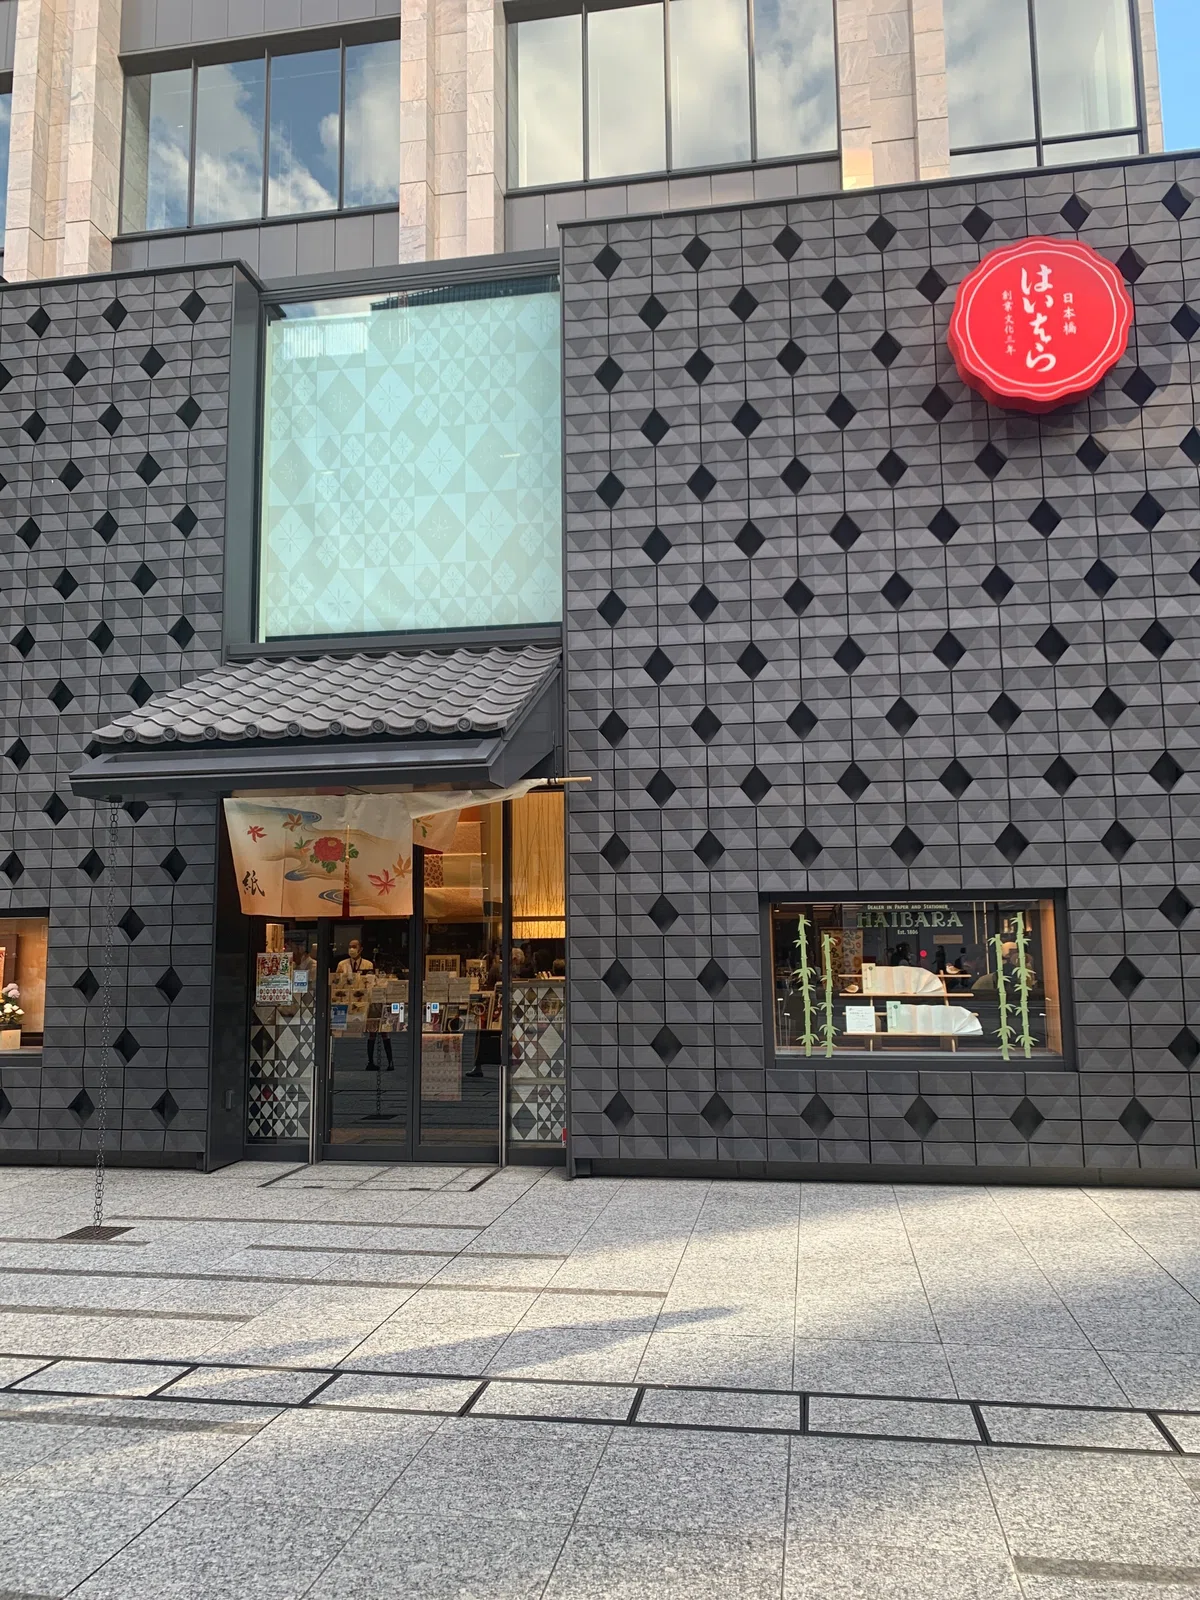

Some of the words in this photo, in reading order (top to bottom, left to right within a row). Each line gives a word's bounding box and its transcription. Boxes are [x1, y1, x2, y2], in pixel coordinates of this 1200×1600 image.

[1063, 292, 1077, 335] 日本橋
[242, 869, 265, 897] 紙
[856, 911, 963, 928] HAIBARA
